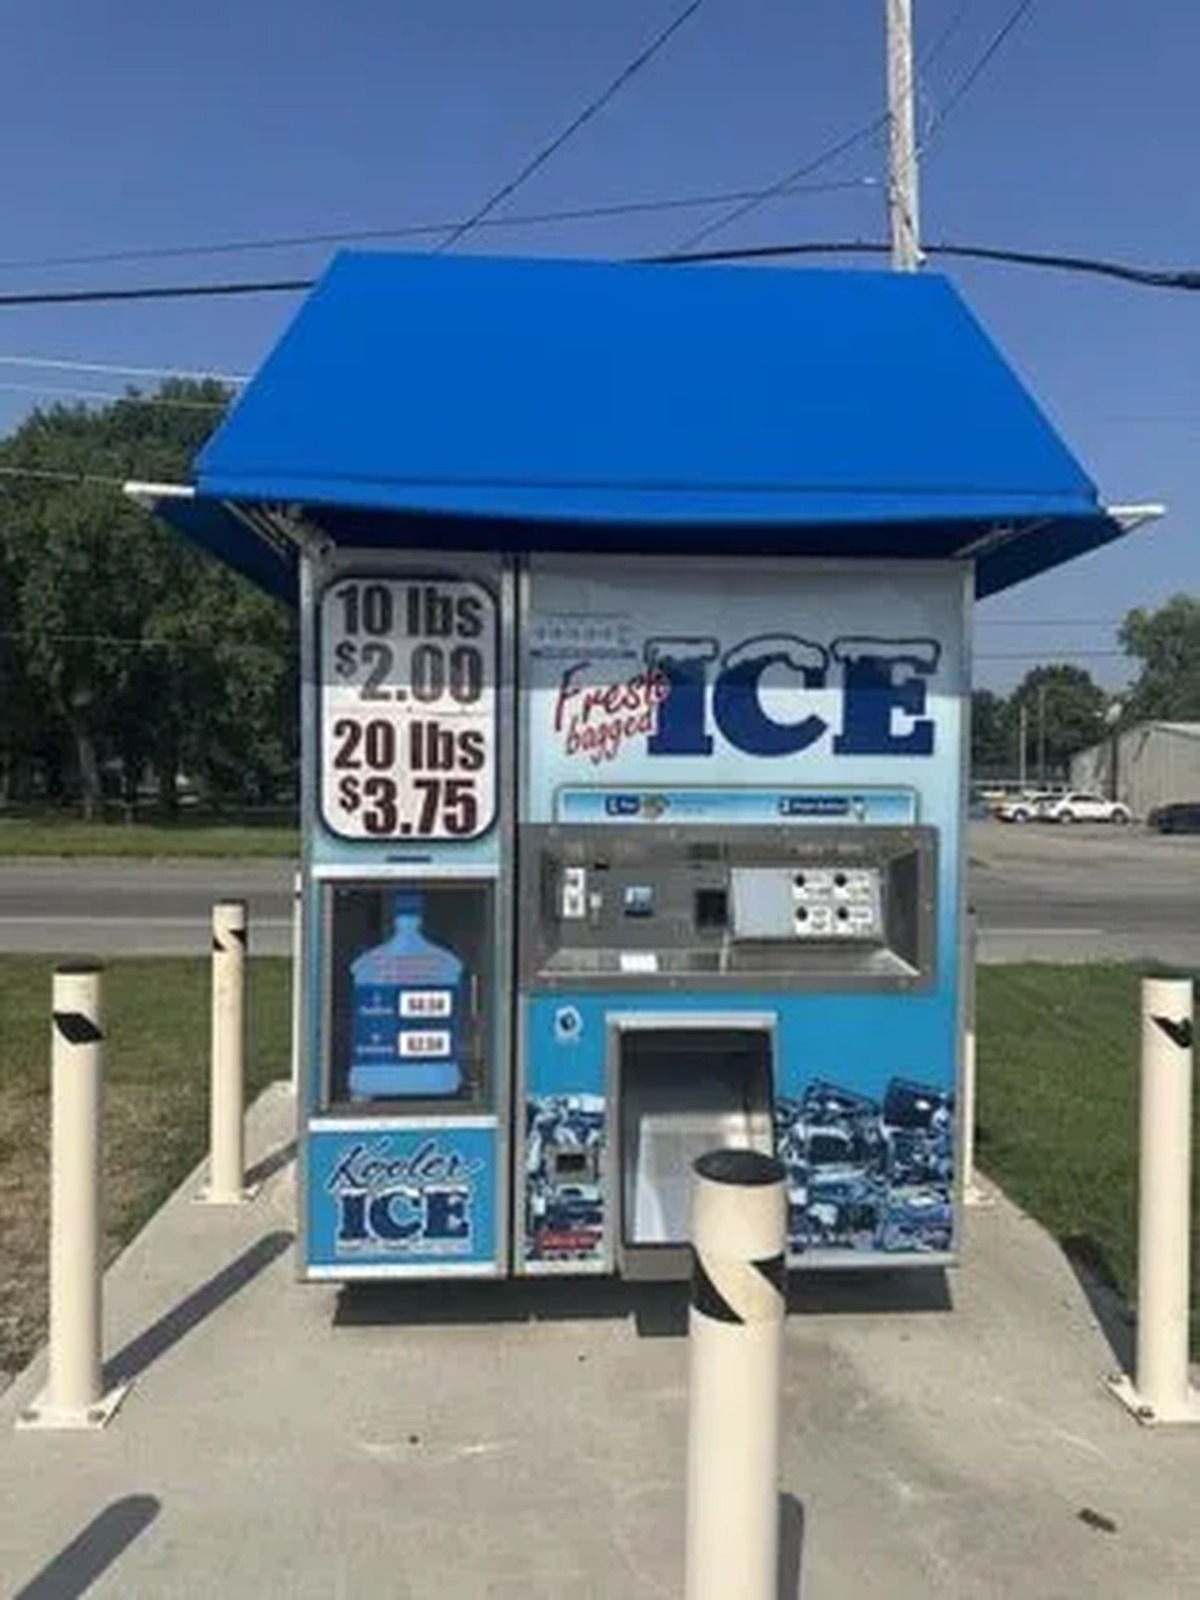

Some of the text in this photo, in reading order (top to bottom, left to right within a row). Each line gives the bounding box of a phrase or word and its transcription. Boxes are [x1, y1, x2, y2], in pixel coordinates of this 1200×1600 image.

[336, 584, 394, 637] 10
[407, 585, 483, 639] lbs
[335, 640, 483, 704] $2.00
[554, 652, 671, 732] Fresh
[644, 632, 941, 757] ICE
[333, 718, 486, 772] 20 lbs
[566, 707, 654, 766] bagged
[338, 774, 477, 835] $3.75
[327, 1140, 482, 1189] Kooler
[337, 1184, 470, 1240] ICE
